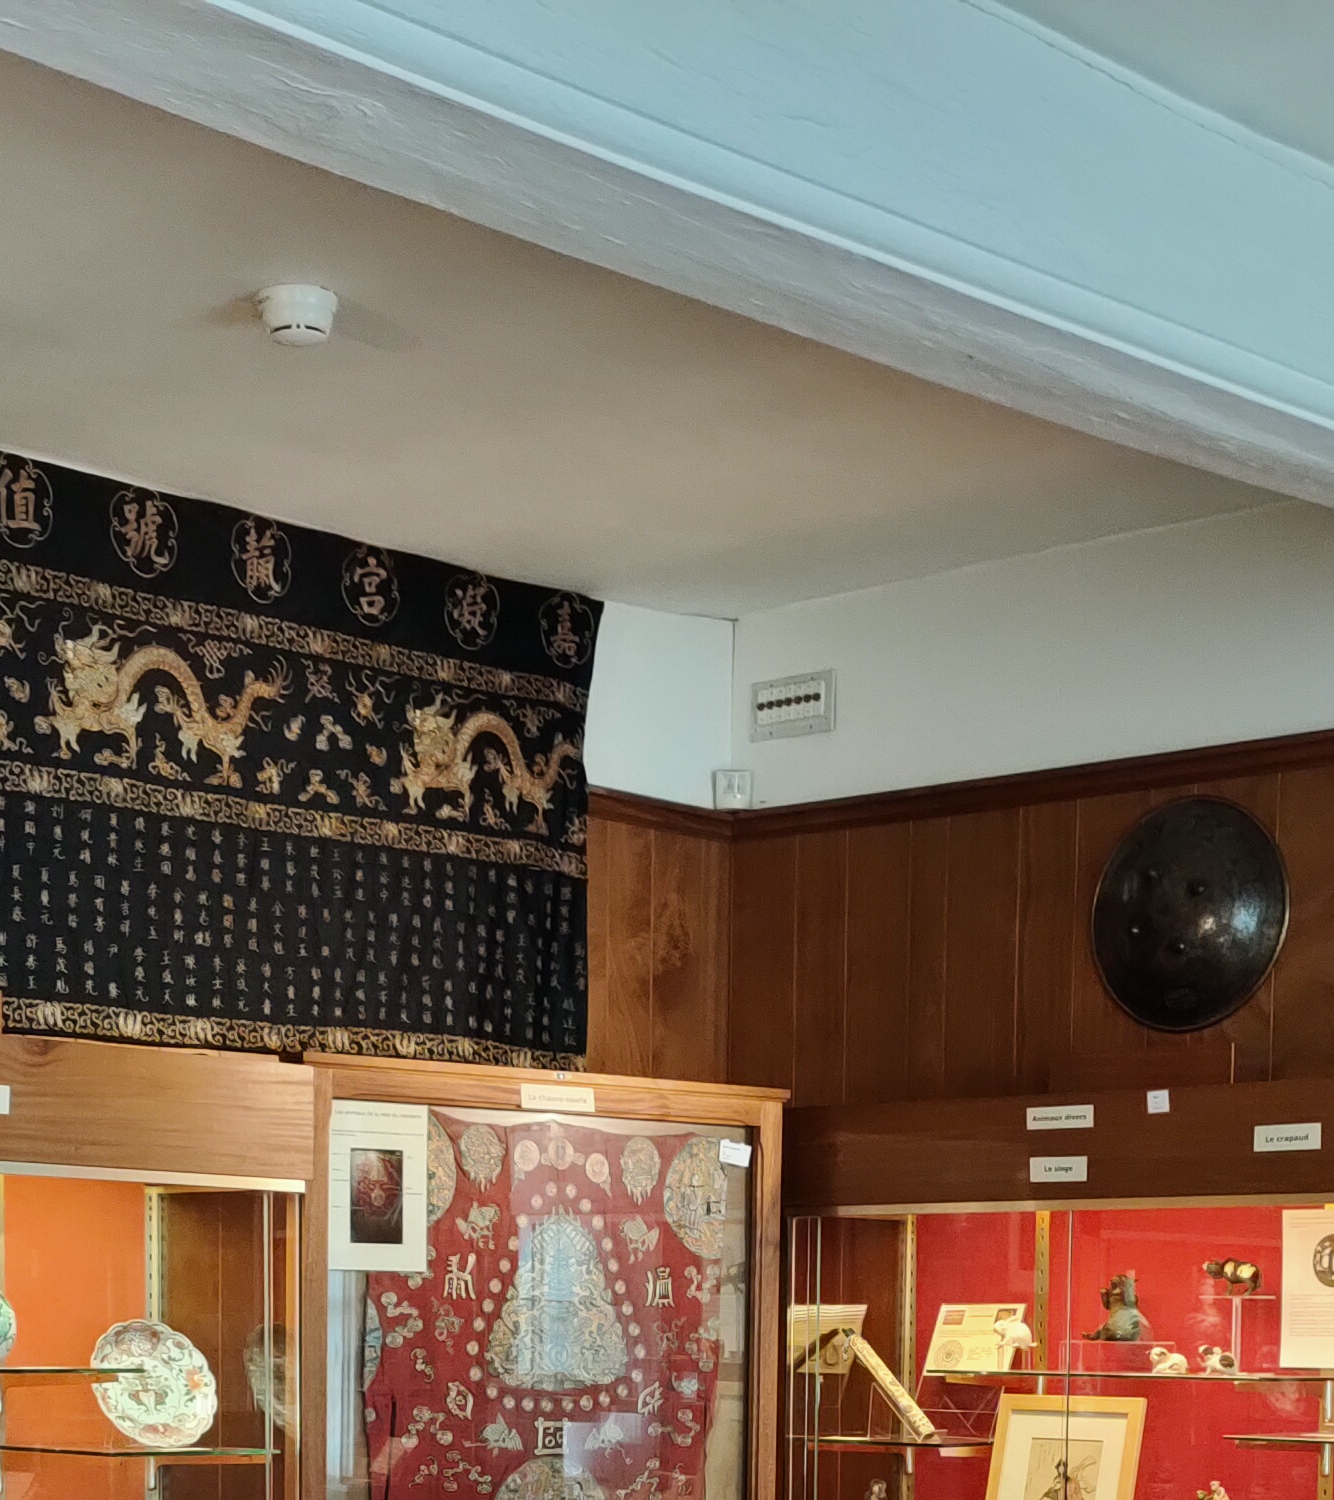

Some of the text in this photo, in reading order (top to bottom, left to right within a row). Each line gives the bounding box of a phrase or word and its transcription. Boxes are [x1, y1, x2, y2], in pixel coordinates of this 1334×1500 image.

[528, 1093, 537, 1102] La
[1064, 1113, 1087, 1121] divers
[1276, 1133, 1309, 1143] crapaud
[1044, 1165, 1073, 1174] Le singe
